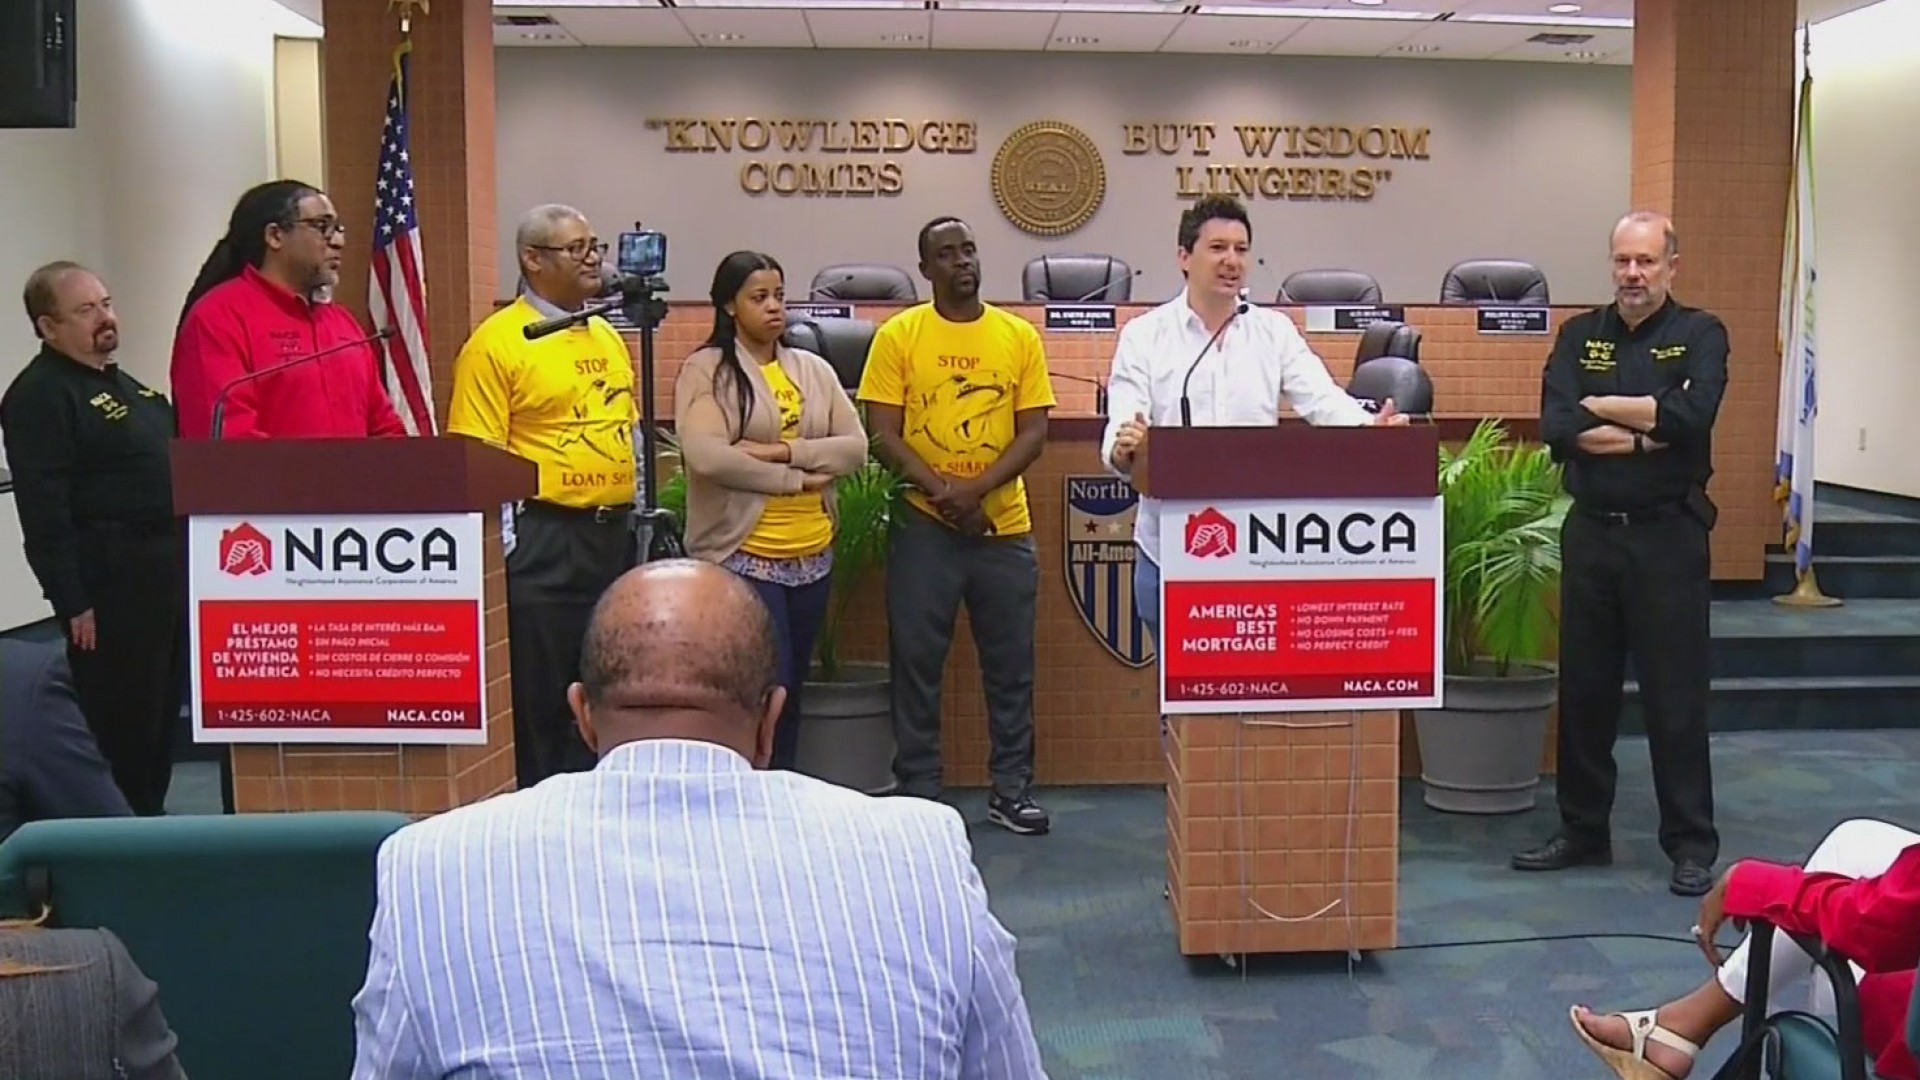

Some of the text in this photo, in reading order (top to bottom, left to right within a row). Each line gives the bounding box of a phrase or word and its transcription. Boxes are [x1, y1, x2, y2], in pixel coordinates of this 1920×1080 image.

[645, 118, 977, 153] "KNOWLEDGE
[1122, 122, 1431, 160] BUT WISDOM
[740, 160, 903, 197] COMES
[1176, 163, 1393, 200] LINGERS"
[574, 358, 609, 374] STOP
[938, 355, 980, 370] STOP
[562, 472, 606, 486] LOAN
[1070, 480, 1129, 499] North
[1249, 512, 1415, 555] NACA
[285, 527, 457, 573] NACA
[1073, 543, 1135, 562] All-Ame
[1188, 604, 1277, 618] AMERICA'S
[1297, 601, 1405, 612] LOWEST INTEREST RATE
[1297, 614, 1389, 624] NO DOWN PAYMENT
[232, 623, 298, 635] EL MEJOR
[313, 623, 325, 632] LA
[328, 623, 349, 632] TASA
[351, 623, 363, 632] DE
[1236, 620, 1277, 635] BEST
[1297, 629, 1311, 638] NO
[1314, 628, 1354, 638] CLOSING
[1357, 628, 1386, 637] COSTS
[1396, 627, 1418, 636] FEES
[227, 635, 298, 649] PRÉSTAMO
[315, 638, 390, 647] SIN PAGO INICIAL
[1182, 637, 1277, 652] MORTGAGE
[1297, 640, 1390, 650] NO PERFECT CREDIT
[212, 652, 299, 664] DE VIVIENDA
[315, 653, 329, 662] SIN
[332, 653, 366, 662] COSTOS
[369, 653, 381, 662] DE
[383, 653, 413, 662] CIERRE
[415, 653, 422, 662] O
[216, 664, 299, 678] EN AMÉRICA
[315, 669, 328, 678] NO
[332, 669, 373, 678] NECESITA
[416, 669, 461, 678] PERFECTO
[1180, 679, 1418, 696] 1-425-602-NACA NACA.COM
[218, 709, 464, 722] 1-425-602-NACA NACA.COM
